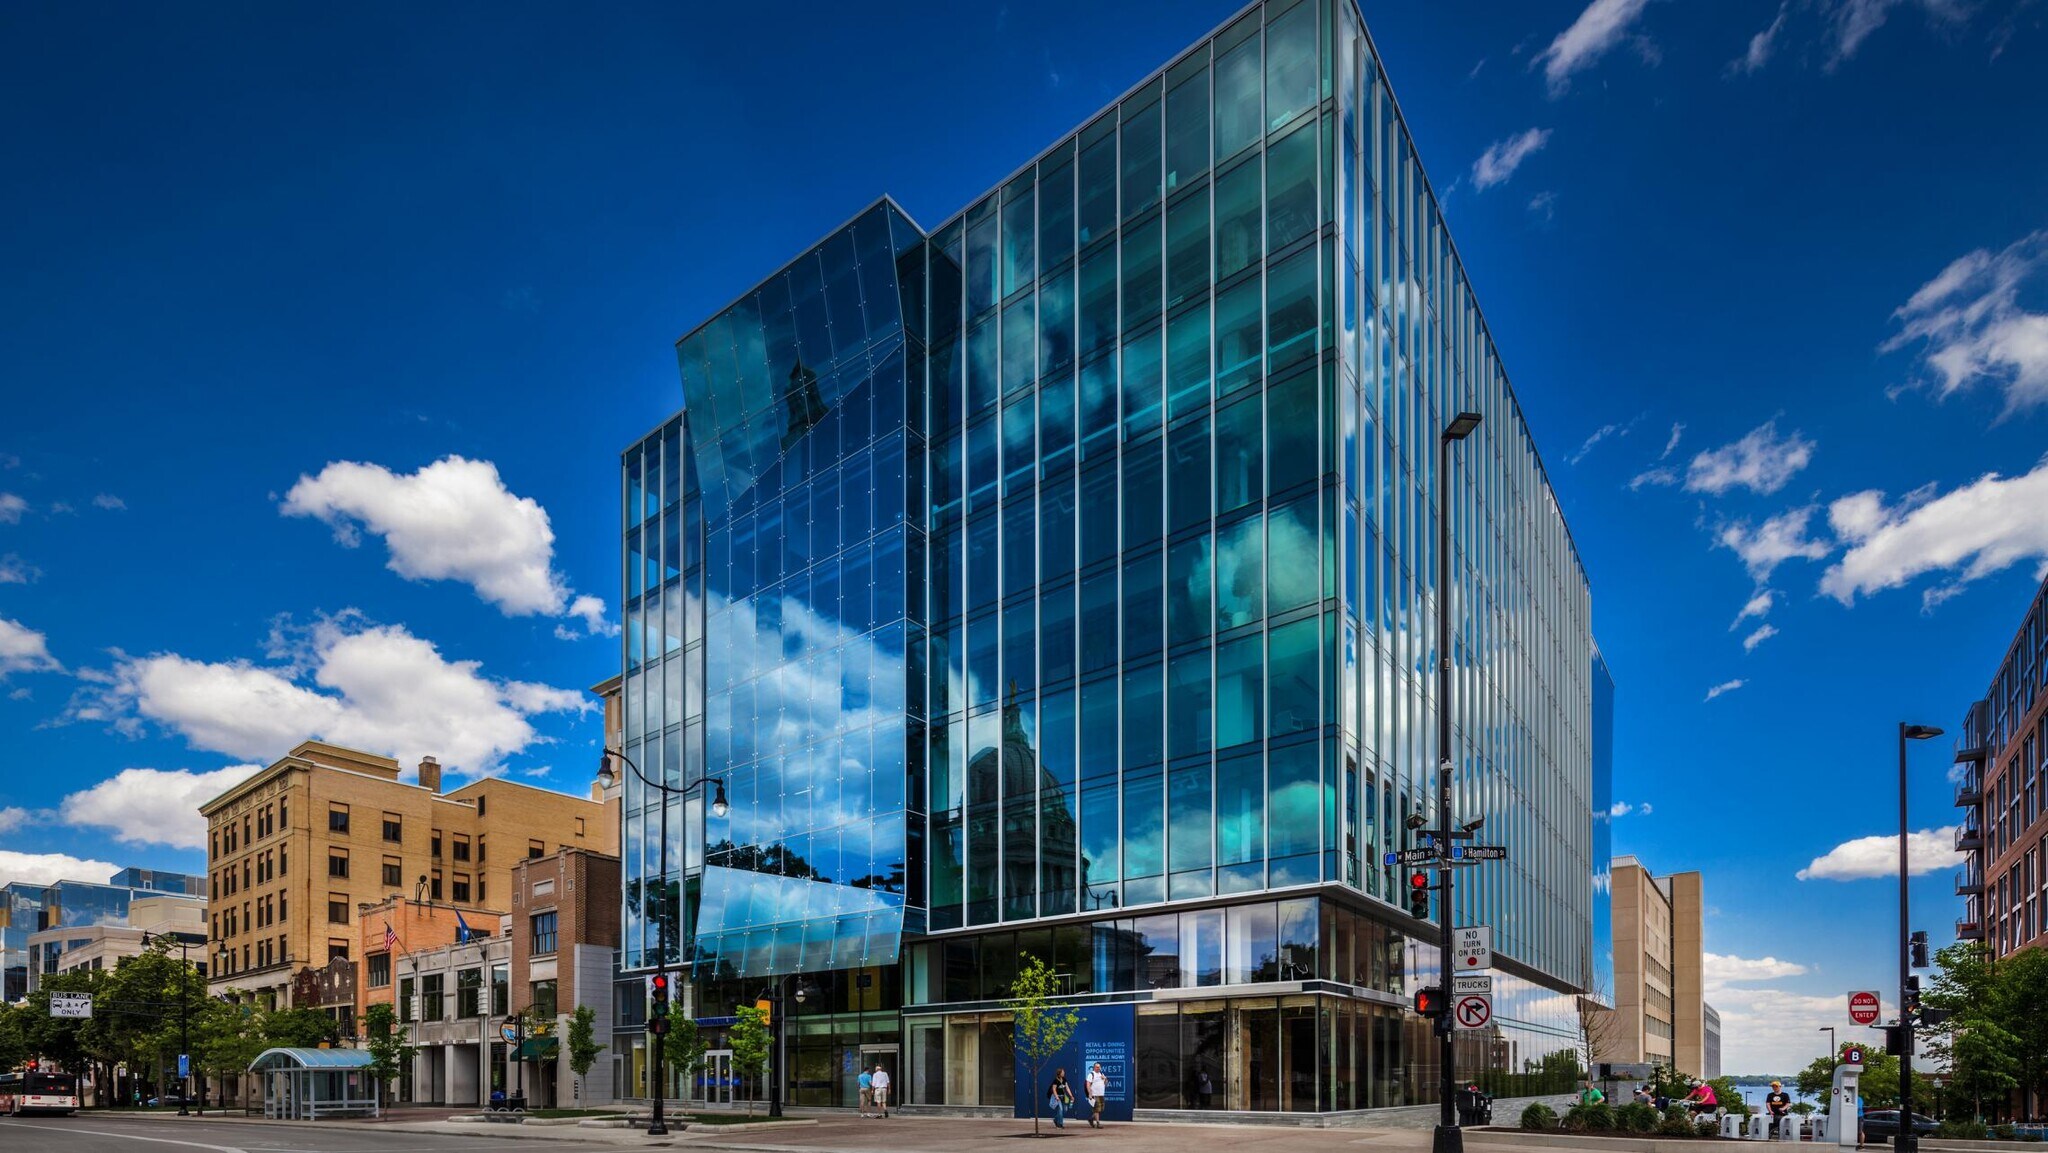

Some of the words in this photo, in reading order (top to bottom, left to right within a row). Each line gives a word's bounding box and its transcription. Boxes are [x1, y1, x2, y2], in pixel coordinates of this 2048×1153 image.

[1405, 851, 1425, 860] Main
[1468, 848, 1498, 858] Hamilton
[1465, 931, 1478, 939] NO
[1463, 940, 1481, 948] TURN
[1852, 1052, 1859, 1061] B
